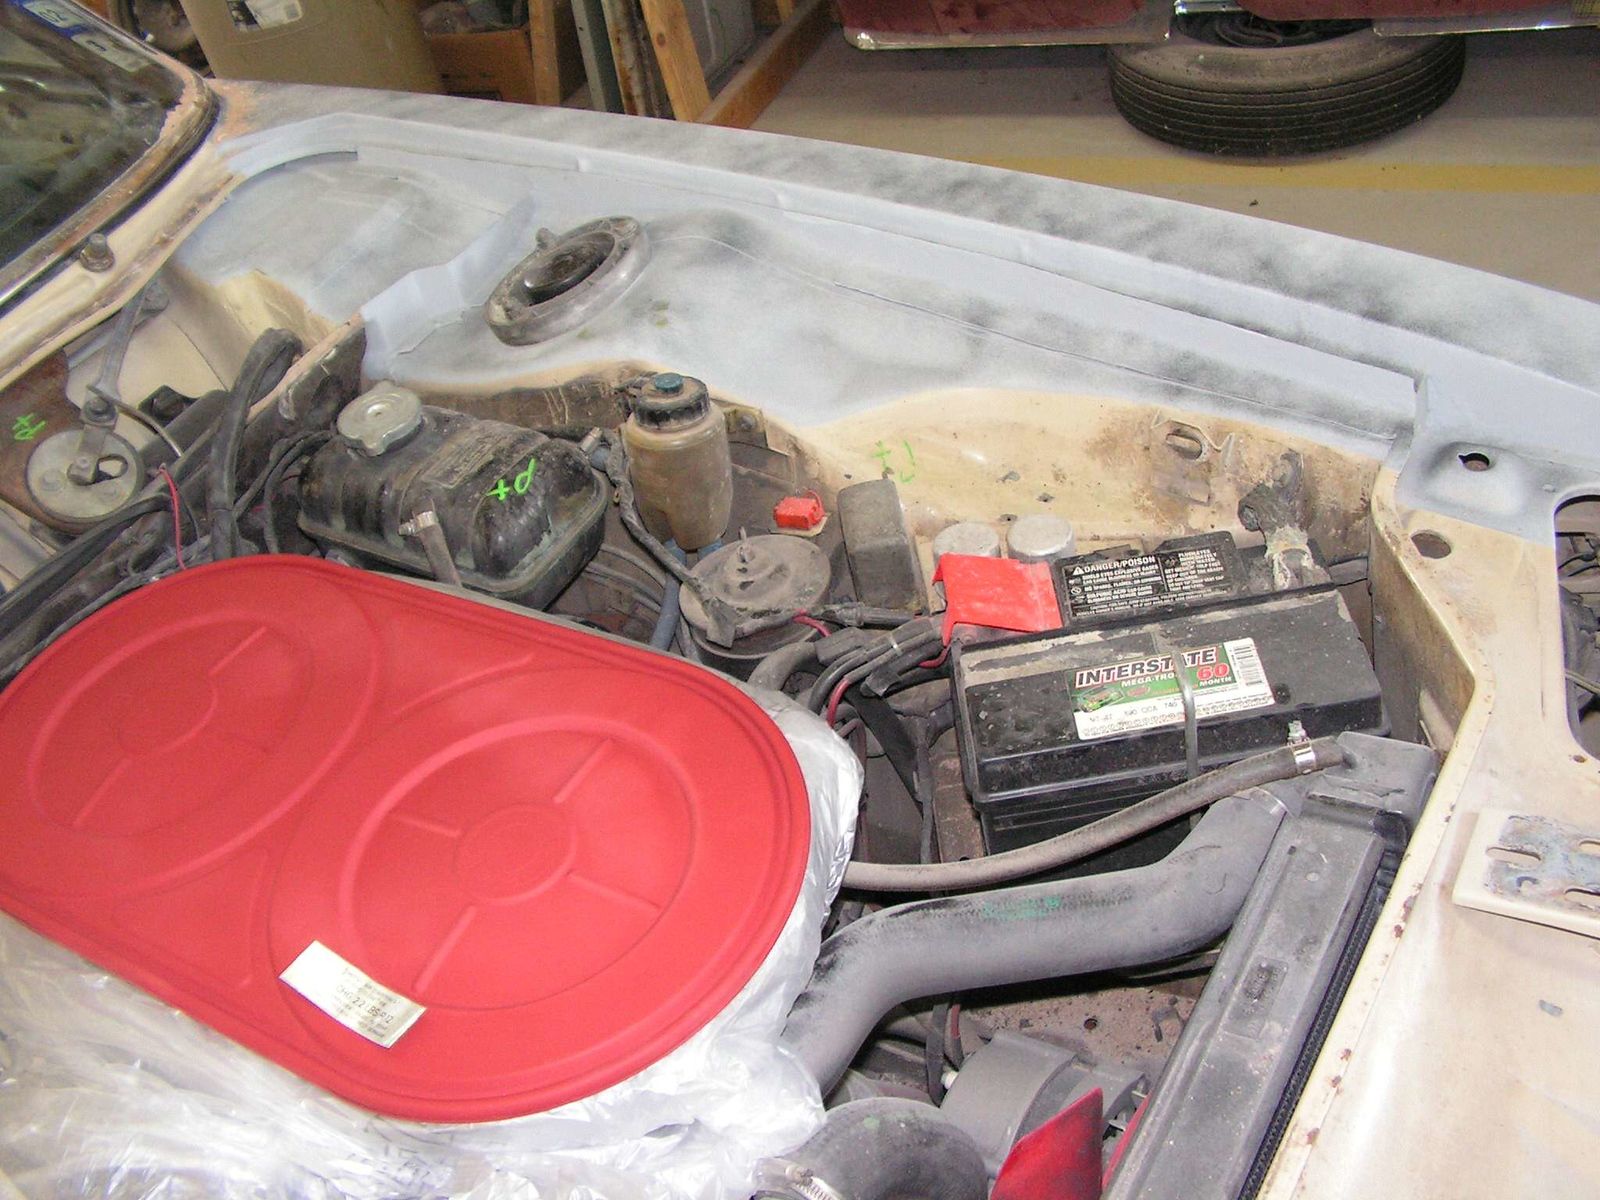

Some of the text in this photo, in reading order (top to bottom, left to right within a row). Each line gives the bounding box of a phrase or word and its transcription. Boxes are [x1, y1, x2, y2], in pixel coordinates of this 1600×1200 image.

[1084, 556, 1156, 573] DANGER/POISON
[1121, 671, 1178, 688] MEGA-TRO
[1196, 662, 1230, 681] 60
[1199, 676, 1232, 687] MONTH
